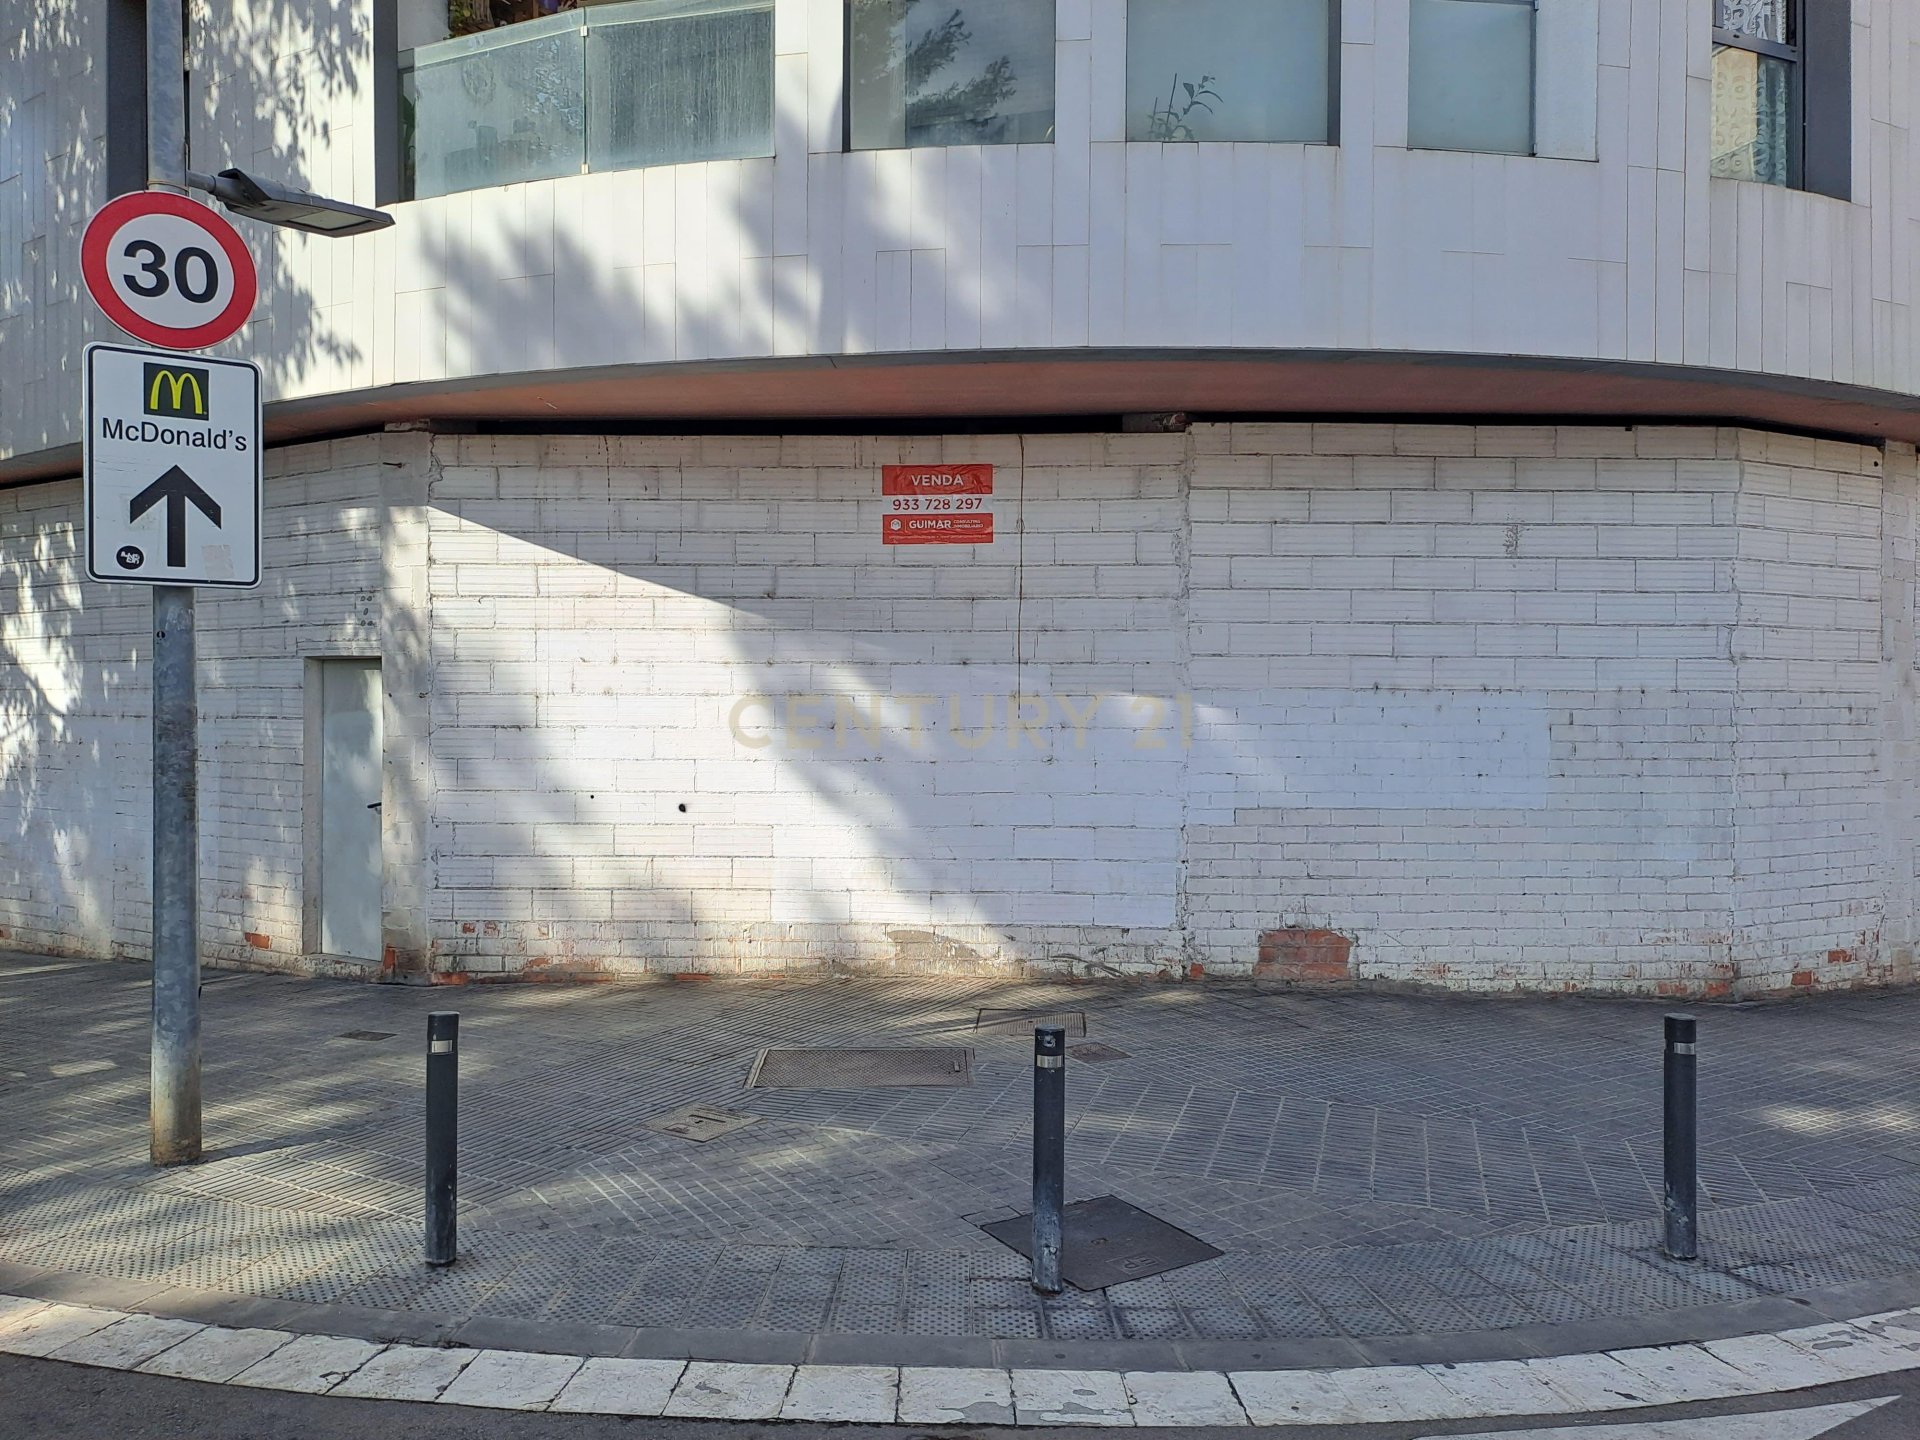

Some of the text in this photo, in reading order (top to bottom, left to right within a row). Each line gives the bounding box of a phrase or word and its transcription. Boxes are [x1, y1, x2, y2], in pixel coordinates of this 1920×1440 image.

[123, 240, 219, 304] 30
[102, 417, 247, 451] McDonald's
[911, 474, 964, 486] VENDA
[892, 497, 982, 511] 933 728 297
[909, 520, 951, 529] GUIMAR
